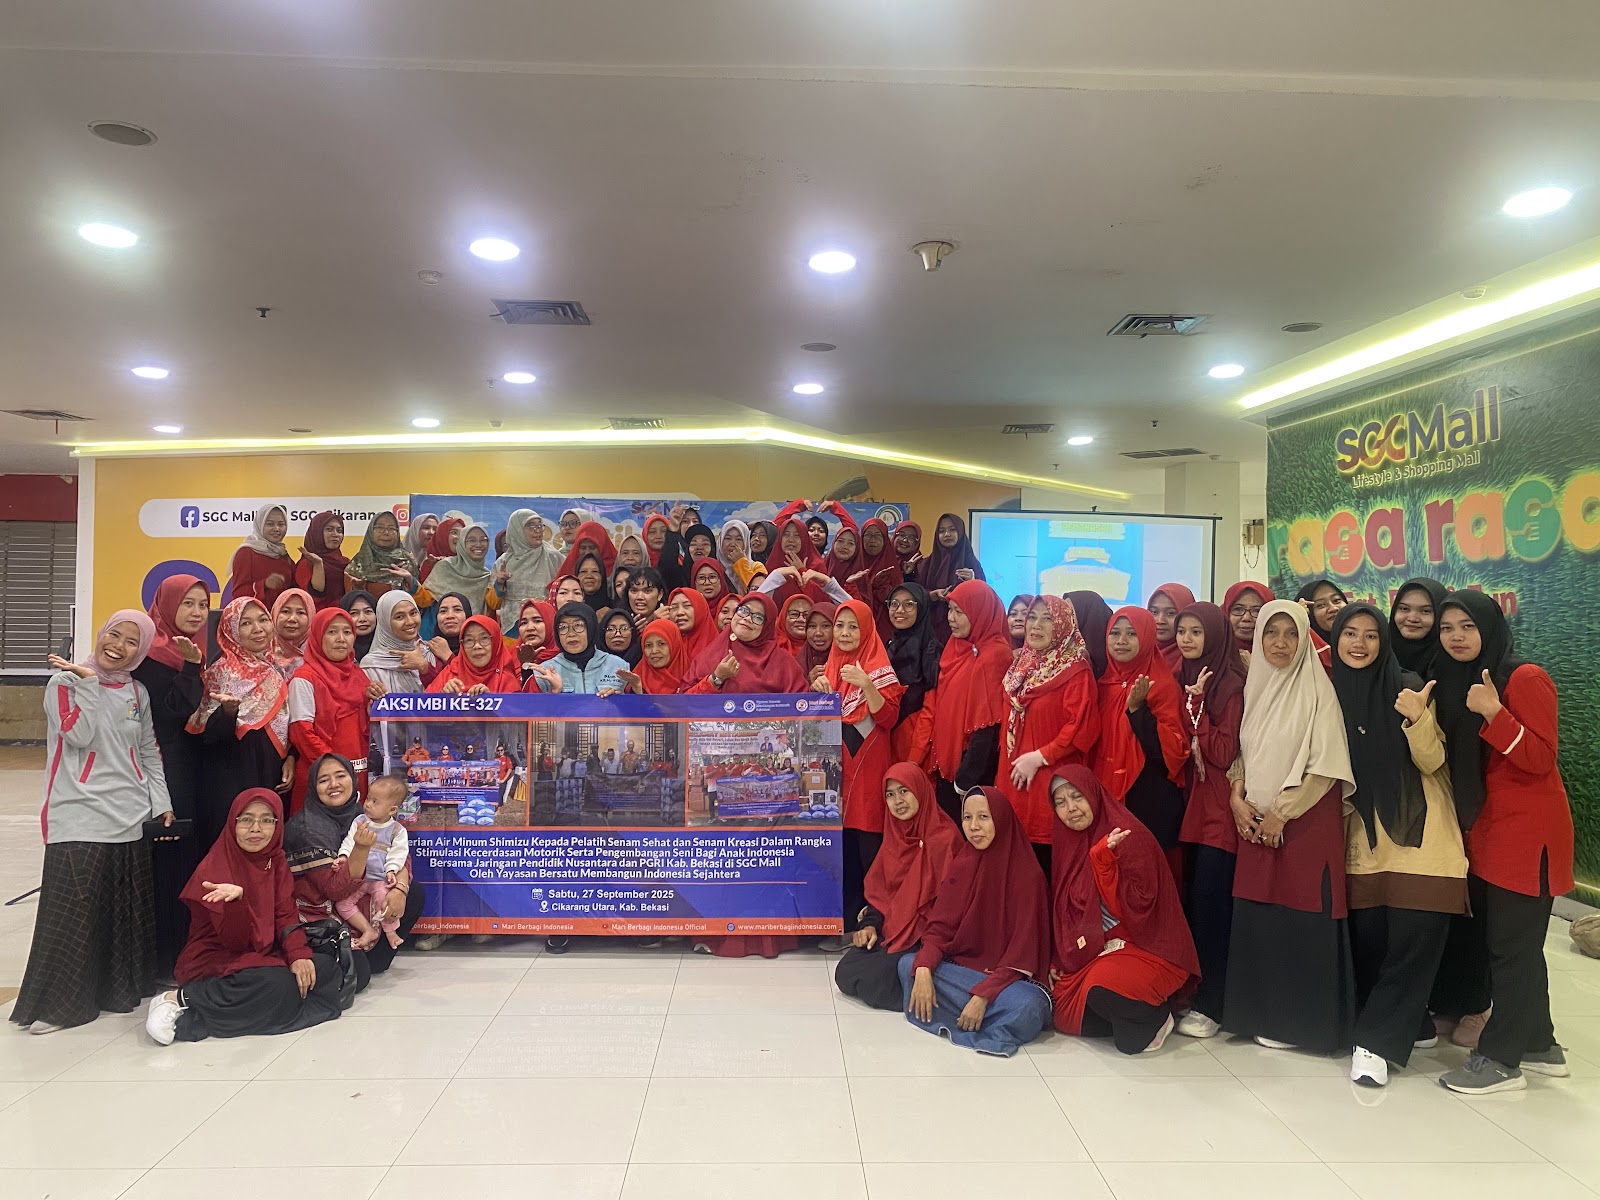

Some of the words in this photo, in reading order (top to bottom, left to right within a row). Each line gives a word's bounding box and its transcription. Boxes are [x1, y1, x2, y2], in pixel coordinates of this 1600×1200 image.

[1352, 469, 1391, 488] Lifestyle
[1394, 467, 1401, 480] &
[1403, 458, 1454, 478] Shopping
[1456, 450, 1481, 469] Mall
[203, 511, 228, 522] SGC
[232, 510, 258, 522] Mall
[376, 697, 414, 711] AKSI
[417, 697, 446, 710] MBI
[450, 697, 503, 710] KE-327
[408, 837, 433, 846] erian
[435, 837, 450, 846] Air
[452, 837, 487, 846] Minum
[489, 837, 529, 846] Shimizu
[531, 837, 569, 848] Kepada
[571, 837, 606, 846] Pelatih
[607, 837, 641, 846] Senam
[642, 838, 671, 847] Sehat
[672, 838, 691, 847] dan
[693, 838, 726, 847] Senam
[727, 838, 759, 847] Kreasi
[761, 837, 793, 846] Dalam
[795, 837, 832, 848] Rangka
[415, 848, 462, 857] Stimulasi
[463, 848, 522, 857] Kecerdasan
[524, 848, 565, 857] Motorik
[567, 848, 594, 857] Serta
[596, 848, 671, 859] Pengembangan
[672, 848, 694, 857] Seni
[695, 848, 717, 859] Bagi
[719, 848, 745, 857] Anak
[747, 847, 795, 857] Indonesia
[430, 858, 472, 868] Bersama
[474, 858, 517, 870] Jaringan
[519, 858, 563, 868] Pendidik
[565, 859, 617, 868] Nusantara
[619, 858, 638, 868] dan
[639, 859, 665, 868] PGRI
[666, 858, 689, 868] Kab.
[690, 859, 723, 869] Bekasi
[724, 858, 734, 868] di
[735, 859, 757, 868] SGC
[758, 857, 781, 868] Mall
[469, 869, 494, 879] Oleh
[496, 869, 538, 880] Yayasan
[540, 869, 578, 879] Bersatu
[580, 869, 642, 881] Membangun
[644, 869, 691, 879] Indonesia
[693, 869, 741, 881] Sejahtera
[548, 889, 581, 900] Sabtu,
[582, 889, 595, 899] 27
[597, 889, 649, 901] September
[651, 890, 674, 899] 2025
[552, 903, 590, 914] Cikarang
[592, 903, 617, 912] Utara,
[619, 903, 639, 912] Kab.
[641, 903, 669, 912] Bekasi
[517, 923, 541, 932] Berbagi
[543, 923, 574, 931] Indonesia
[627, 923, 652, 932] Berbagi
[684, 923, 707, 931] Official
